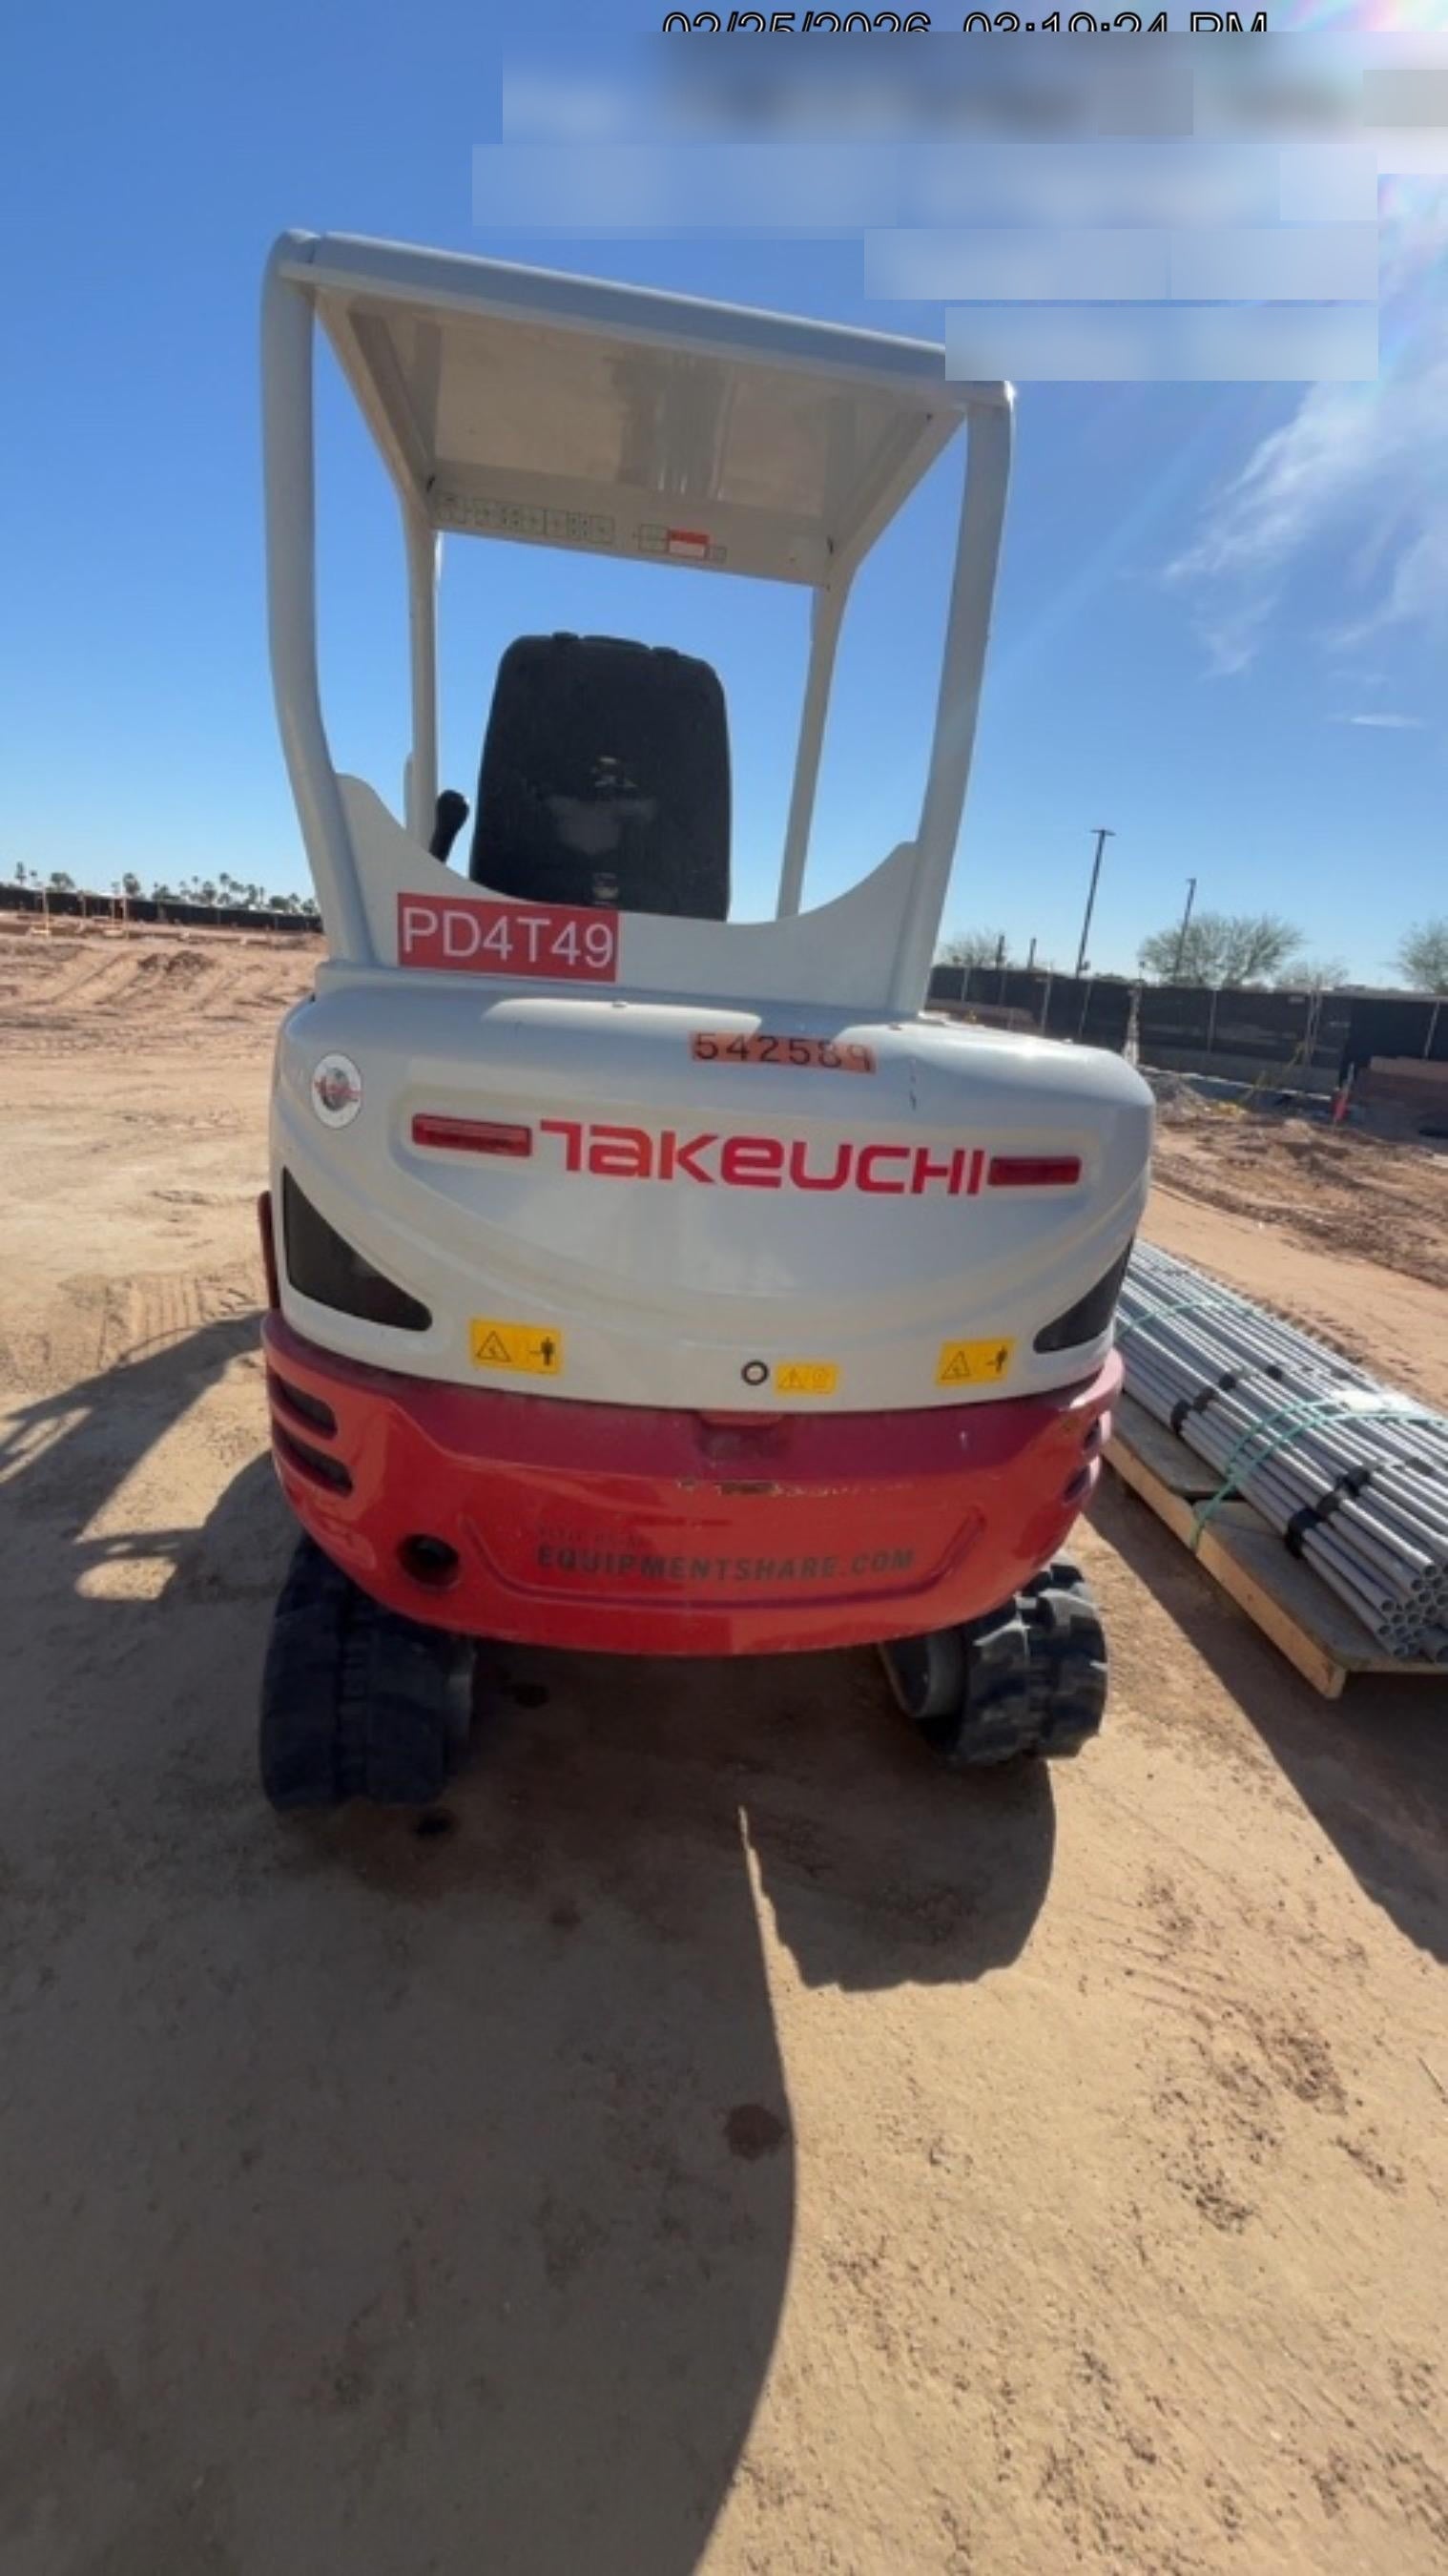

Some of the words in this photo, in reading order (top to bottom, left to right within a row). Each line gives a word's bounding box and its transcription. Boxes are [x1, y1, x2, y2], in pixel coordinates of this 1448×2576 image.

[403, 907, 614, 969] PD4T49
[693, 1032, 872, 1071] 542589
[537, 1544, 916, 1581] EQUIPMENTSHARE.COM
